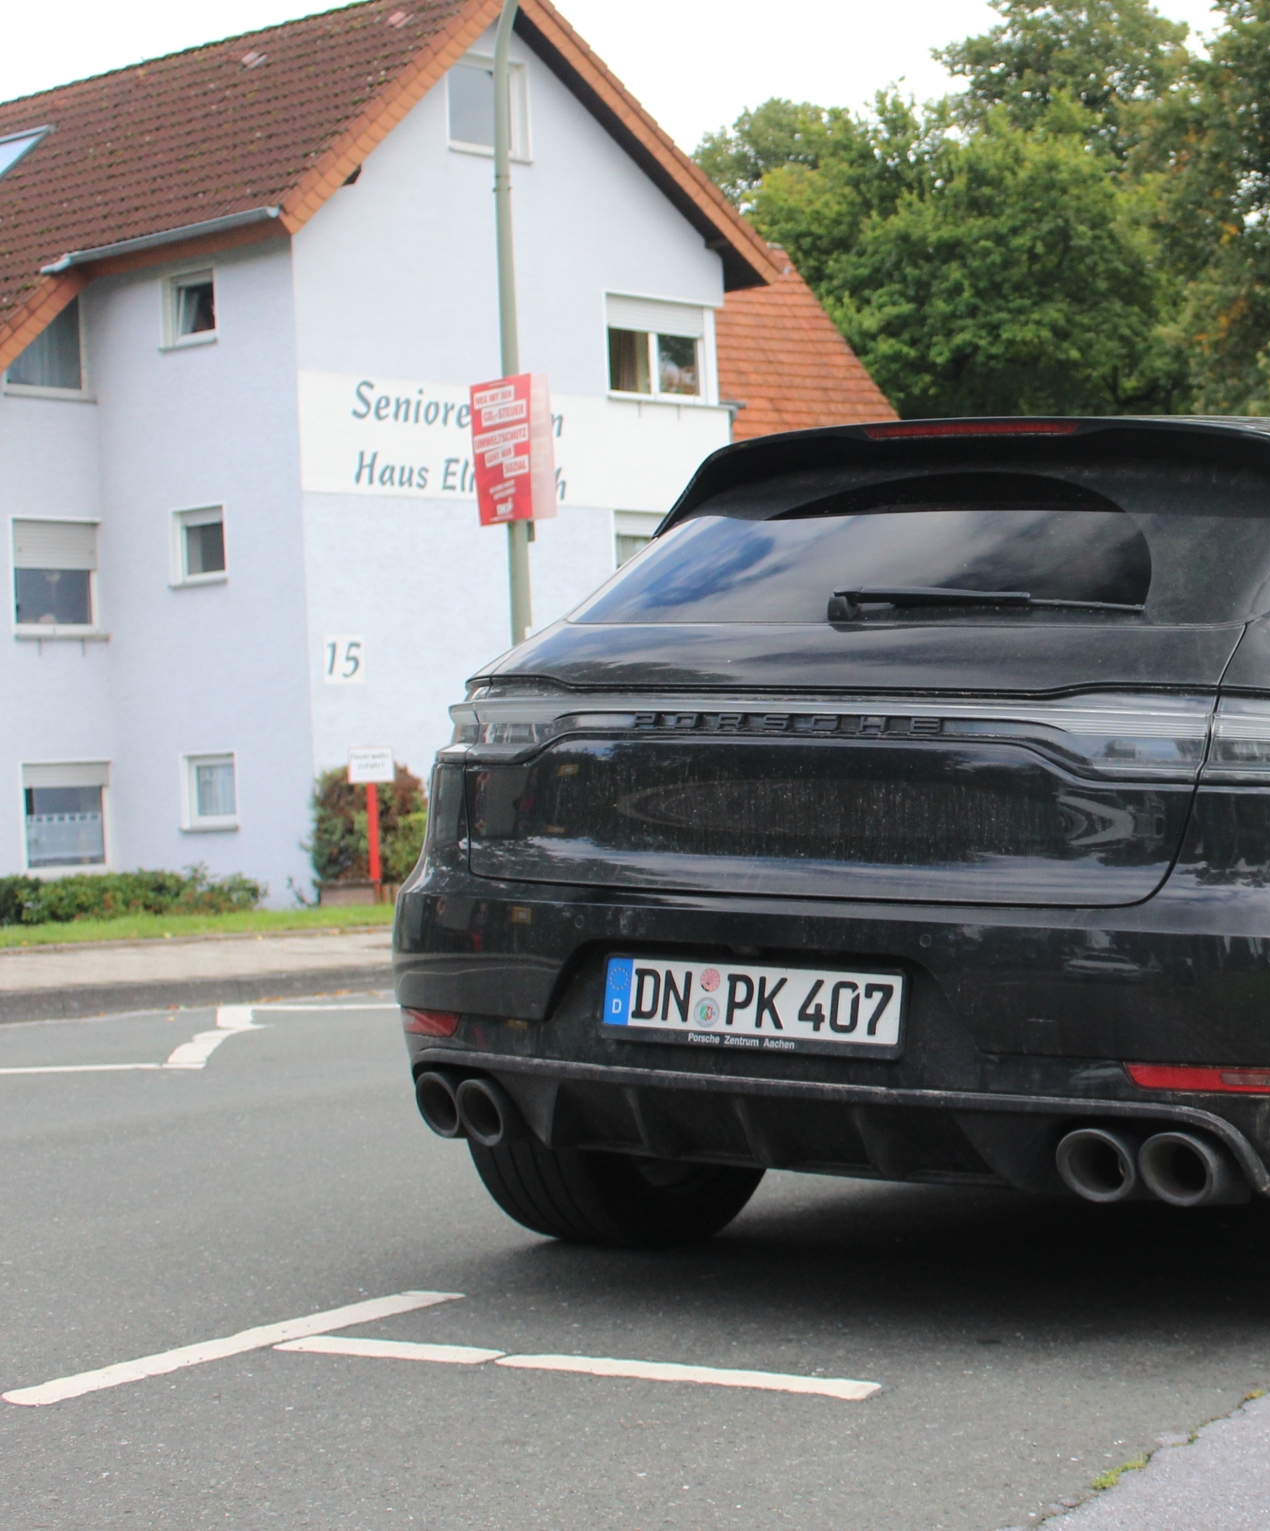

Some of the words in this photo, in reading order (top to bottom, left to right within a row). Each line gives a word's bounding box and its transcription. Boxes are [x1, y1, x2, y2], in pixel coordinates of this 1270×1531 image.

[354, 450, 429, 490] Haus
[327, 641, 361, 679] 15
[632, 711, 942, 735] PORSCHE
[611, 998, 622, 1014] D
[631, 967, 693, 1023] DN
[725, 973, 788, 1031] PK
[798, 979, 894, 1037] 407
[687, 1031, 720, 1045] Porsche
[723, 1034, 760, 1047] Zentrum
[763, 1037, 796, 1051] Aachen
